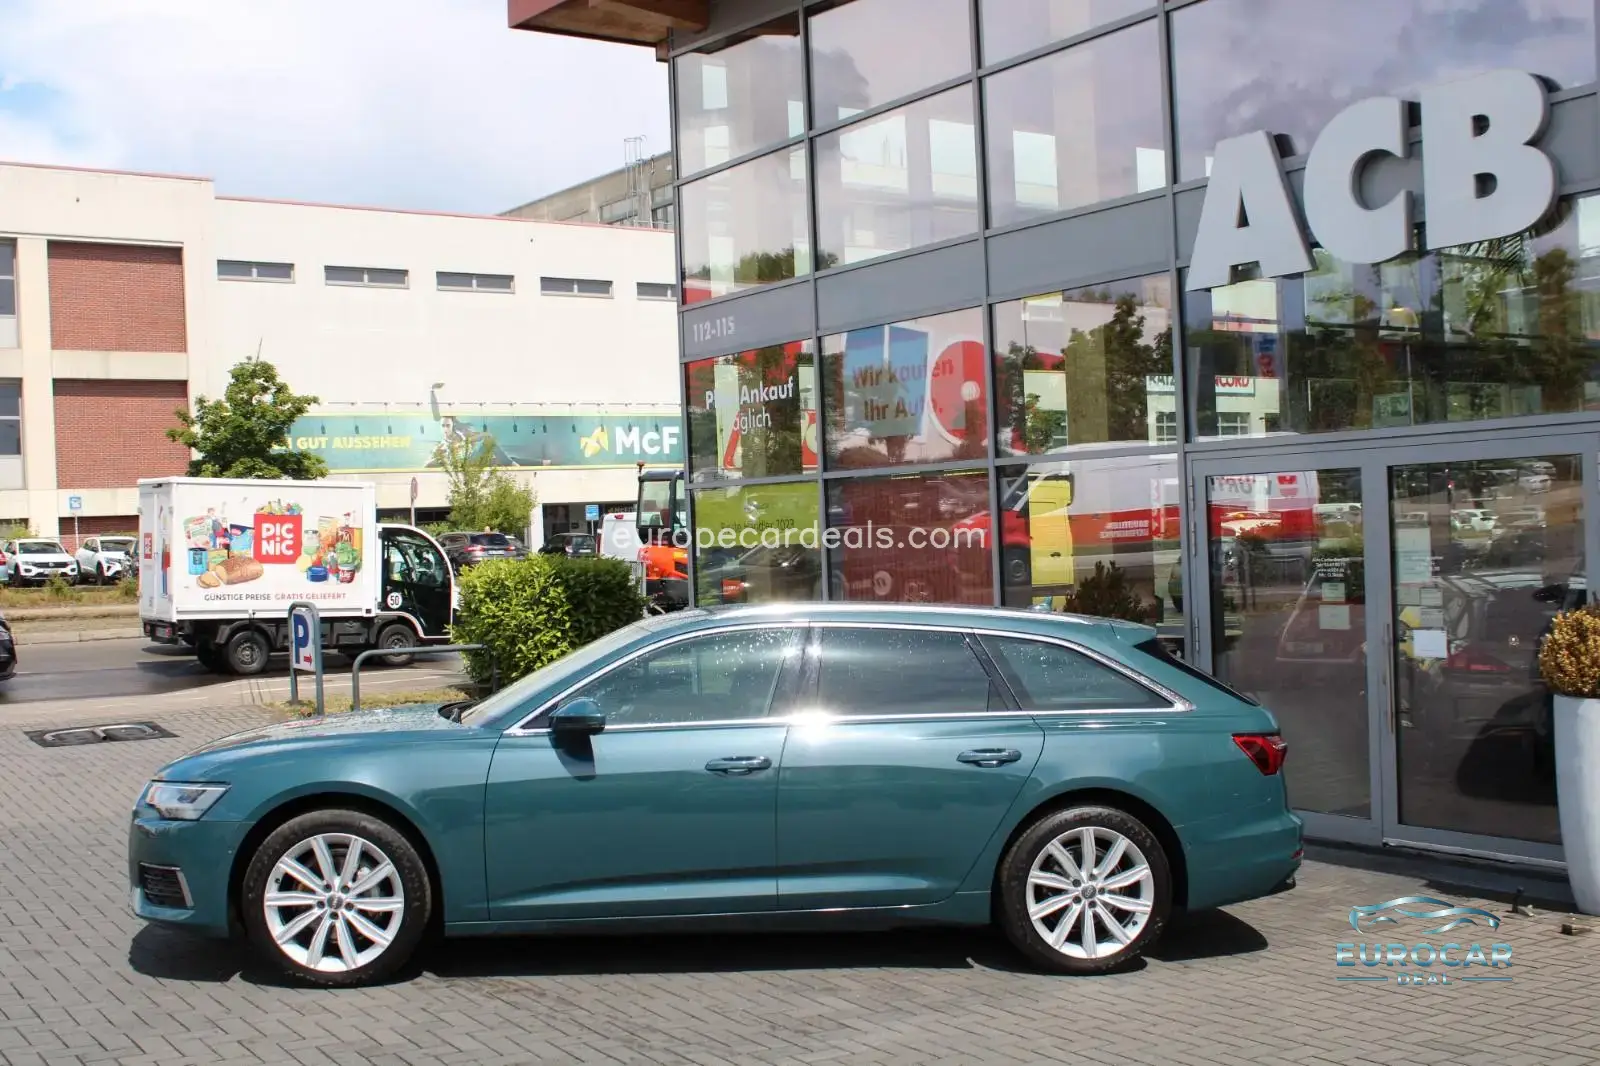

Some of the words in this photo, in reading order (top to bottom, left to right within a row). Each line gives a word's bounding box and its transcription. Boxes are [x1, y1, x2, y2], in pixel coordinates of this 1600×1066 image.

[1186, 69, 1559, 291] ACB
[692, 316, 736, 343] 112-115
[852, 363, 883, 389] Wir
[740, 376, 794, 404] Ankauf
[733, 406, 772, 435] äglich
[863, 397, 889, 421] Ihr
[297, 437, 329, 450] GUT
[332, 435, 412, 449] AUSSEHEN
[615, 426, 680, 455] McF
[204, 592, 243, 601] GÜNSTIGE
[245, 593, 271, 601] PREISE
[305, 592, 347, 600] GELIEFERT
[390, 595, 400, 606] 50
[293, 613, 310, 665] P
